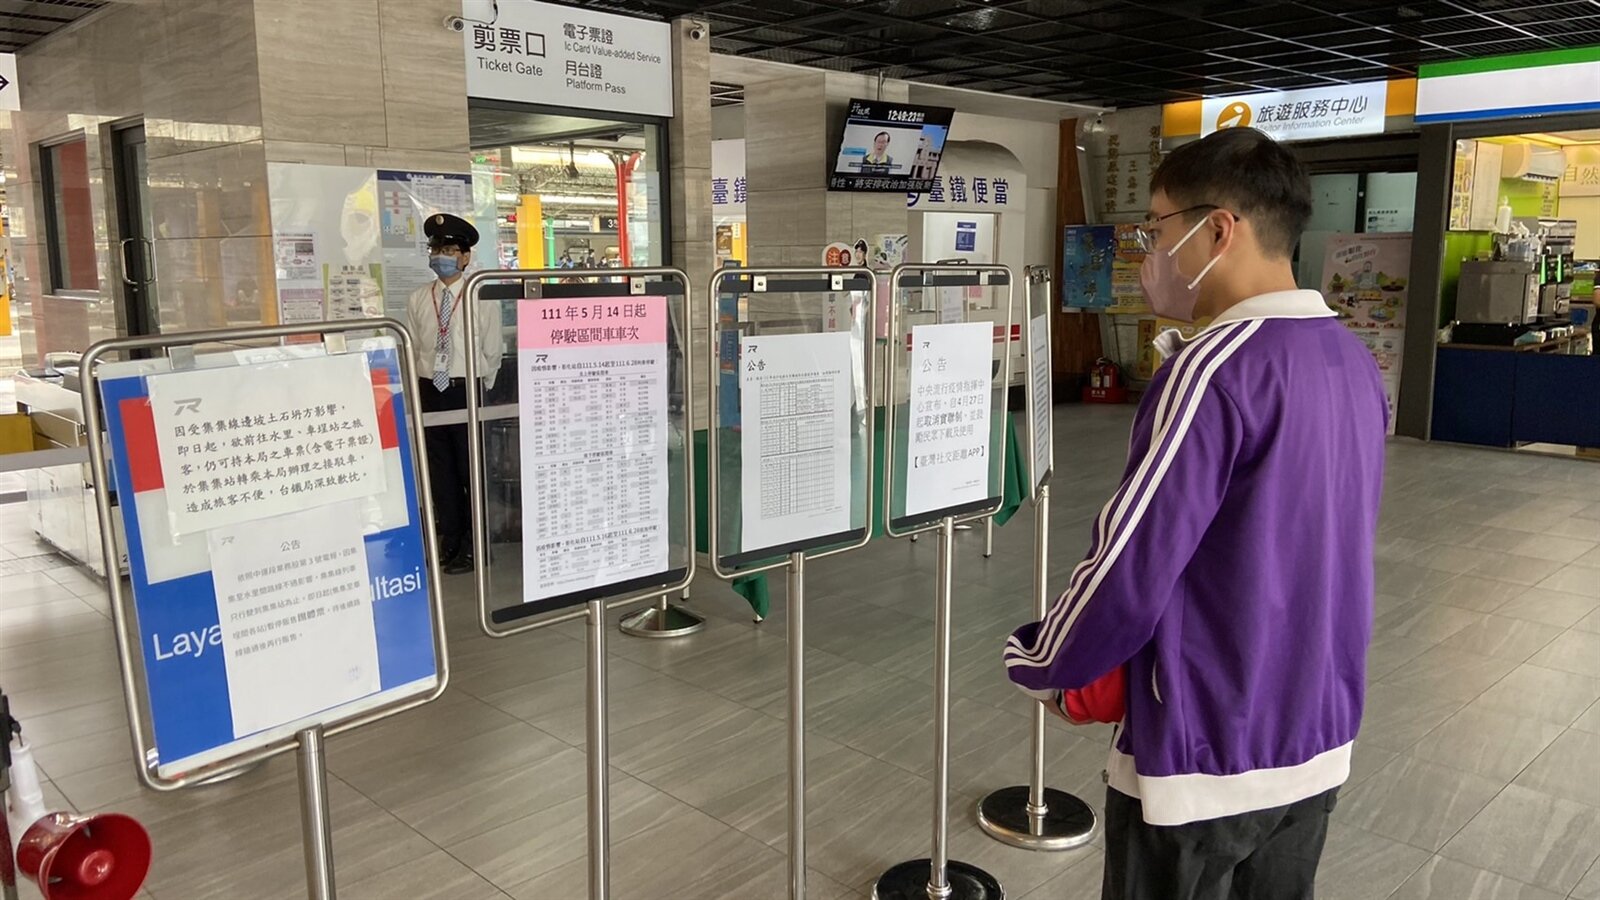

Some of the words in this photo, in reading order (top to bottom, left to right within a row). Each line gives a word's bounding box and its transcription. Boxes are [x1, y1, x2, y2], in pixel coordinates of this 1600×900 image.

[473, 24, 546, 58] 剪票口
[562, 22, 614, 45] 電子票證
[572, 42, 591, 54] Card
[591, 44, 635, 60] Value-added
[637, 51, 661, 64] Service
[477, 56, 512, 73] Ticket
[515, 61, 543, 77] Gate
[565, 60, 603, 79] 月台證
[566, 78, 603, 92] Platform
[605, 82, 626, 94] Pass
[1256, 95, 1368, 123] 旅遊服務中心
[1282, 118, 1331, 130] Information
[1333, 116, 1365, 126] Center
[928, 176, 1009, 205] 臺鐵便當
[541, 308, 561, 320] 111
[565, 305, 579, 321] 年
[581, 307, 588, 318] 5
[591, 305, 603, 320] 月
[607, 306, 619, 317] 14
[623, 303, 647, 318] 日起
[550, 326, 639, 345] 停駛區間車車次
[747, 359, 766, 372] 公告
[280, 540, 301, 552] 公告
